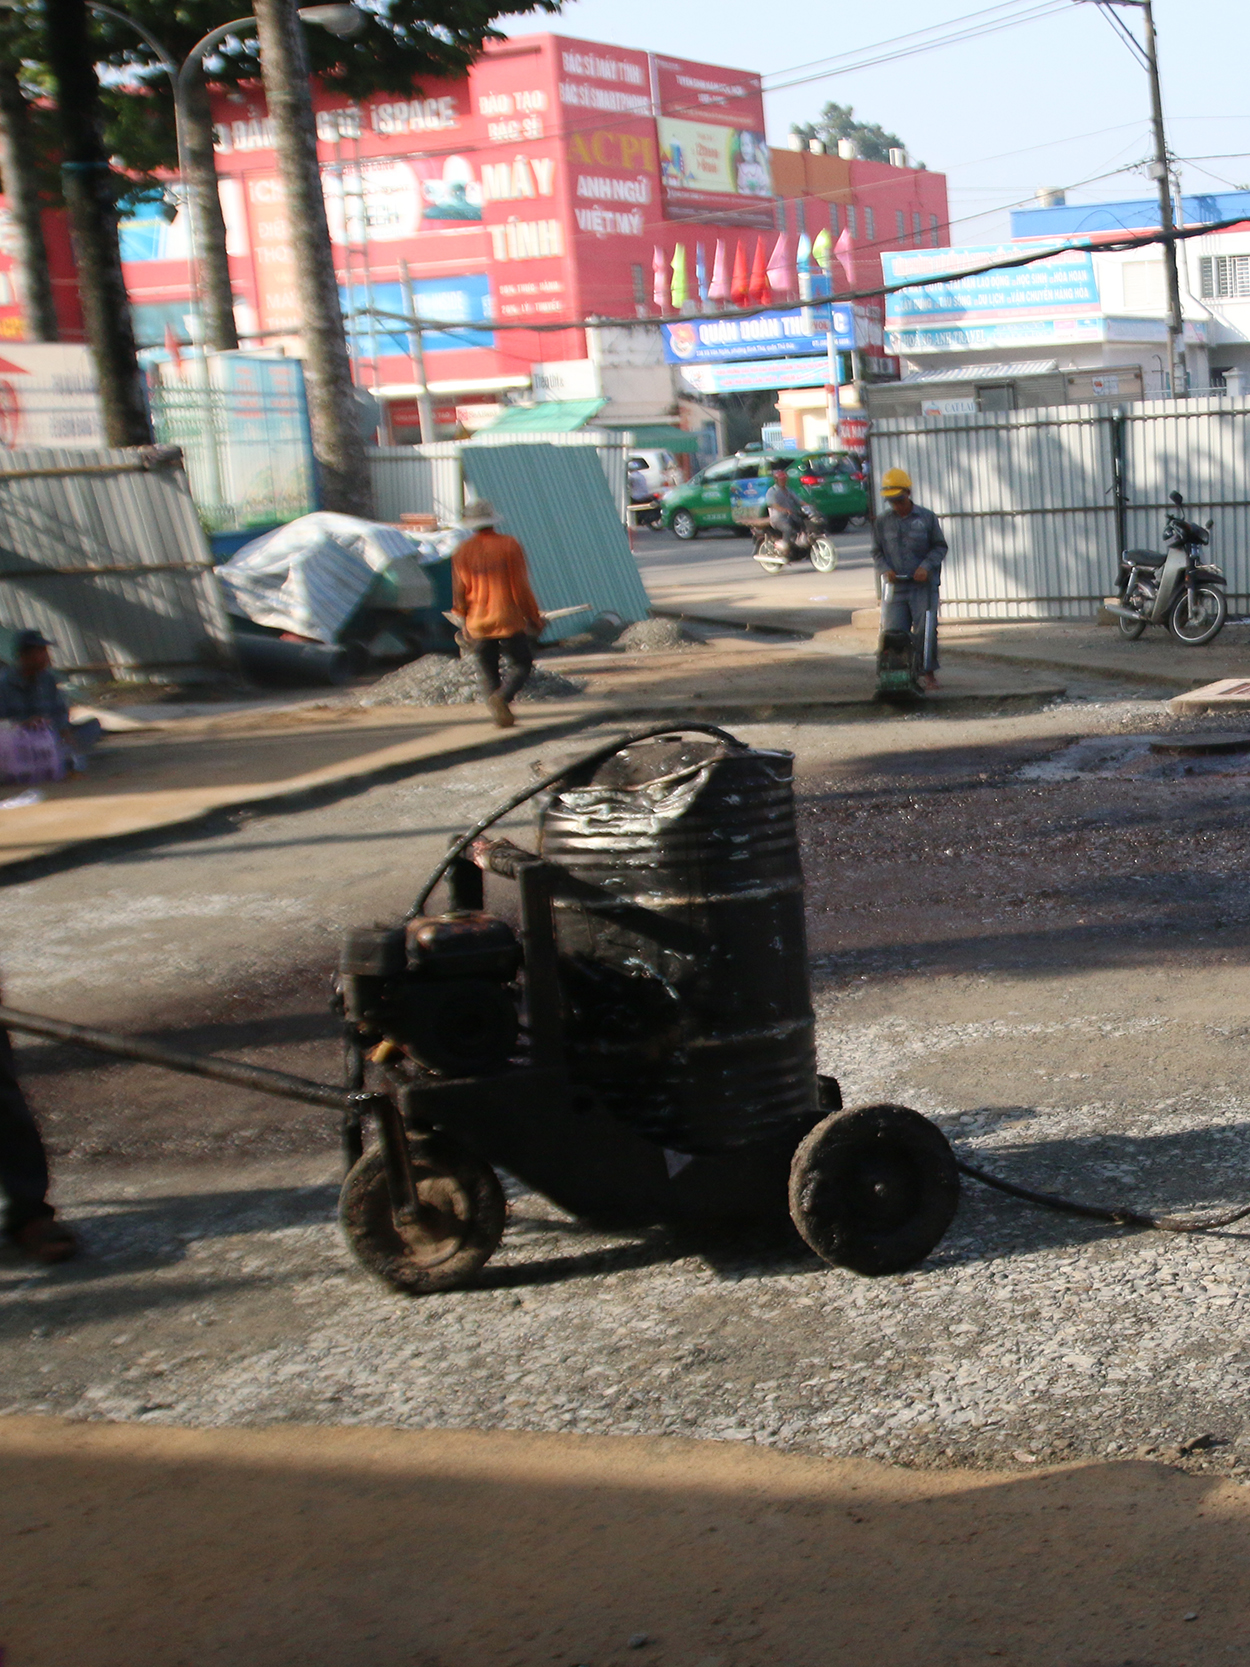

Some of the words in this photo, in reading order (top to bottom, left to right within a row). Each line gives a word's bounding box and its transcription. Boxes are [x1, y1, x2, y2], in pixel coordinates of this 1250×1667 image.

[370, 96, 456, 135] iSPACE
[577, 175, 612, 199] ANH
[977, 275, 990, 288] LAO
[1016, 273, 1030, 288] HỌC
[1031, 272, 1048, 285] SINH
[699, 320, 736, 345] QUẬN
[739, 316, 780, 340] ĐOÀN
[952, 329, 986, 345] TRAVEL
